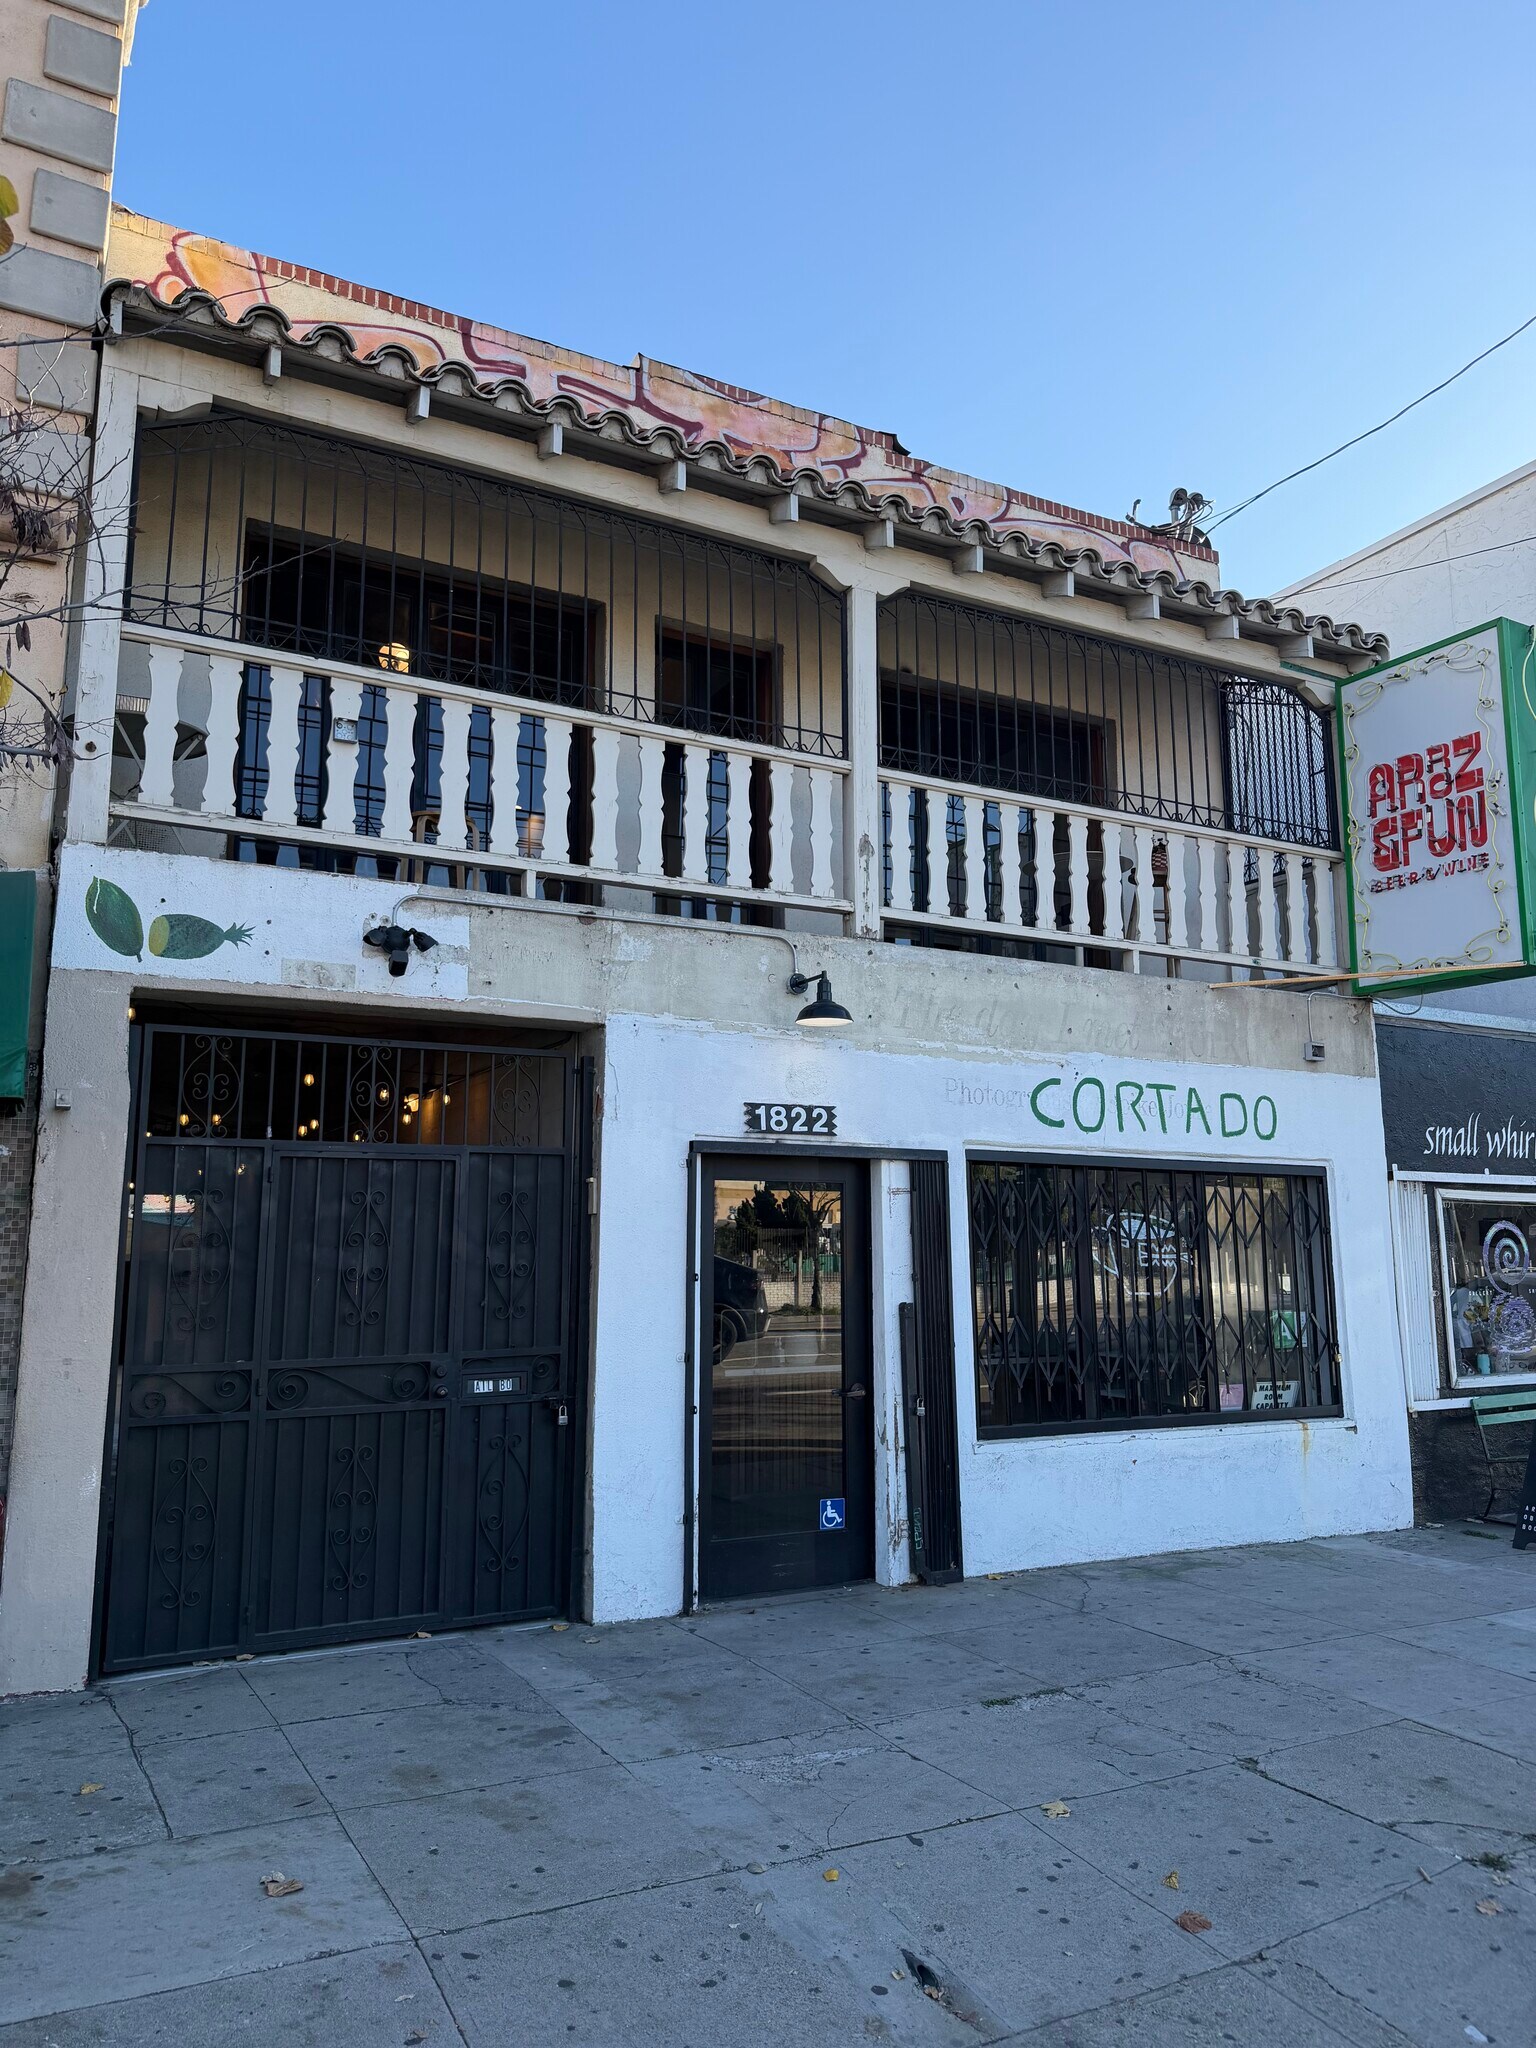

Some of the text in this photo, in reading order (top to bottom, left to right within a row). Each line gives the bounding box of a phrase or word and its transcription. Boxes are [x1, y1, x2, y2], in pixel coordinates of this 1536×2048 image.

[755, 1105, 829, 1133] 1822
[1029, 1076, 1278, 1141] CORTADO
[1423, 1112, 1481, 1157] small
[1263, 1393, 1283, 1401] ROM
